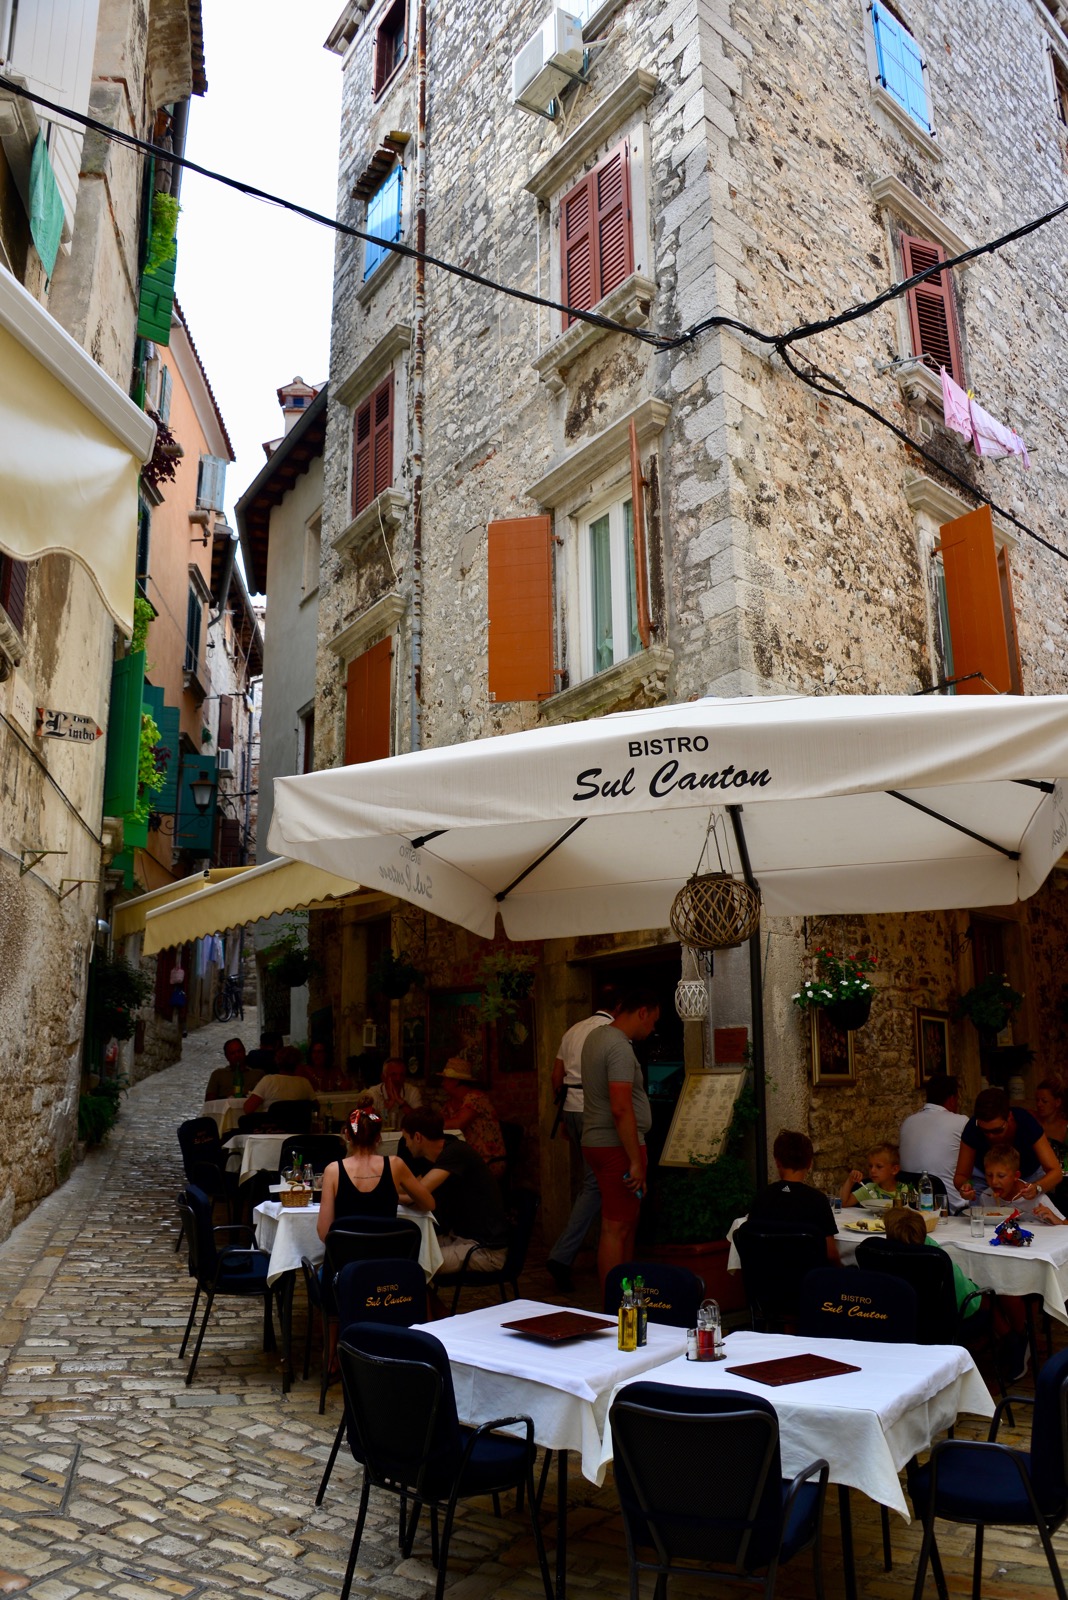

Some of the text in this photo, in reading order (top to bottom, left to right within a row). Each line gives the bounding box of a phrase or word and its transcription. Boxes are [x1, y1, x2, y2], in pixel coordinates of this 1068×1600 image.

[45, 711, 95, 741] Limbo
[628, 735, 709, 757] BISTRO
[572, 759, 772, 801] Sul Canton
[376, 1284, 399, 1293] BISTRO
[365, 1293, 413, 1307] Sul Canton
[841, 1294, 872, 1304] BISTRO
[821, 1302, 888, 1319] Sul Canton
